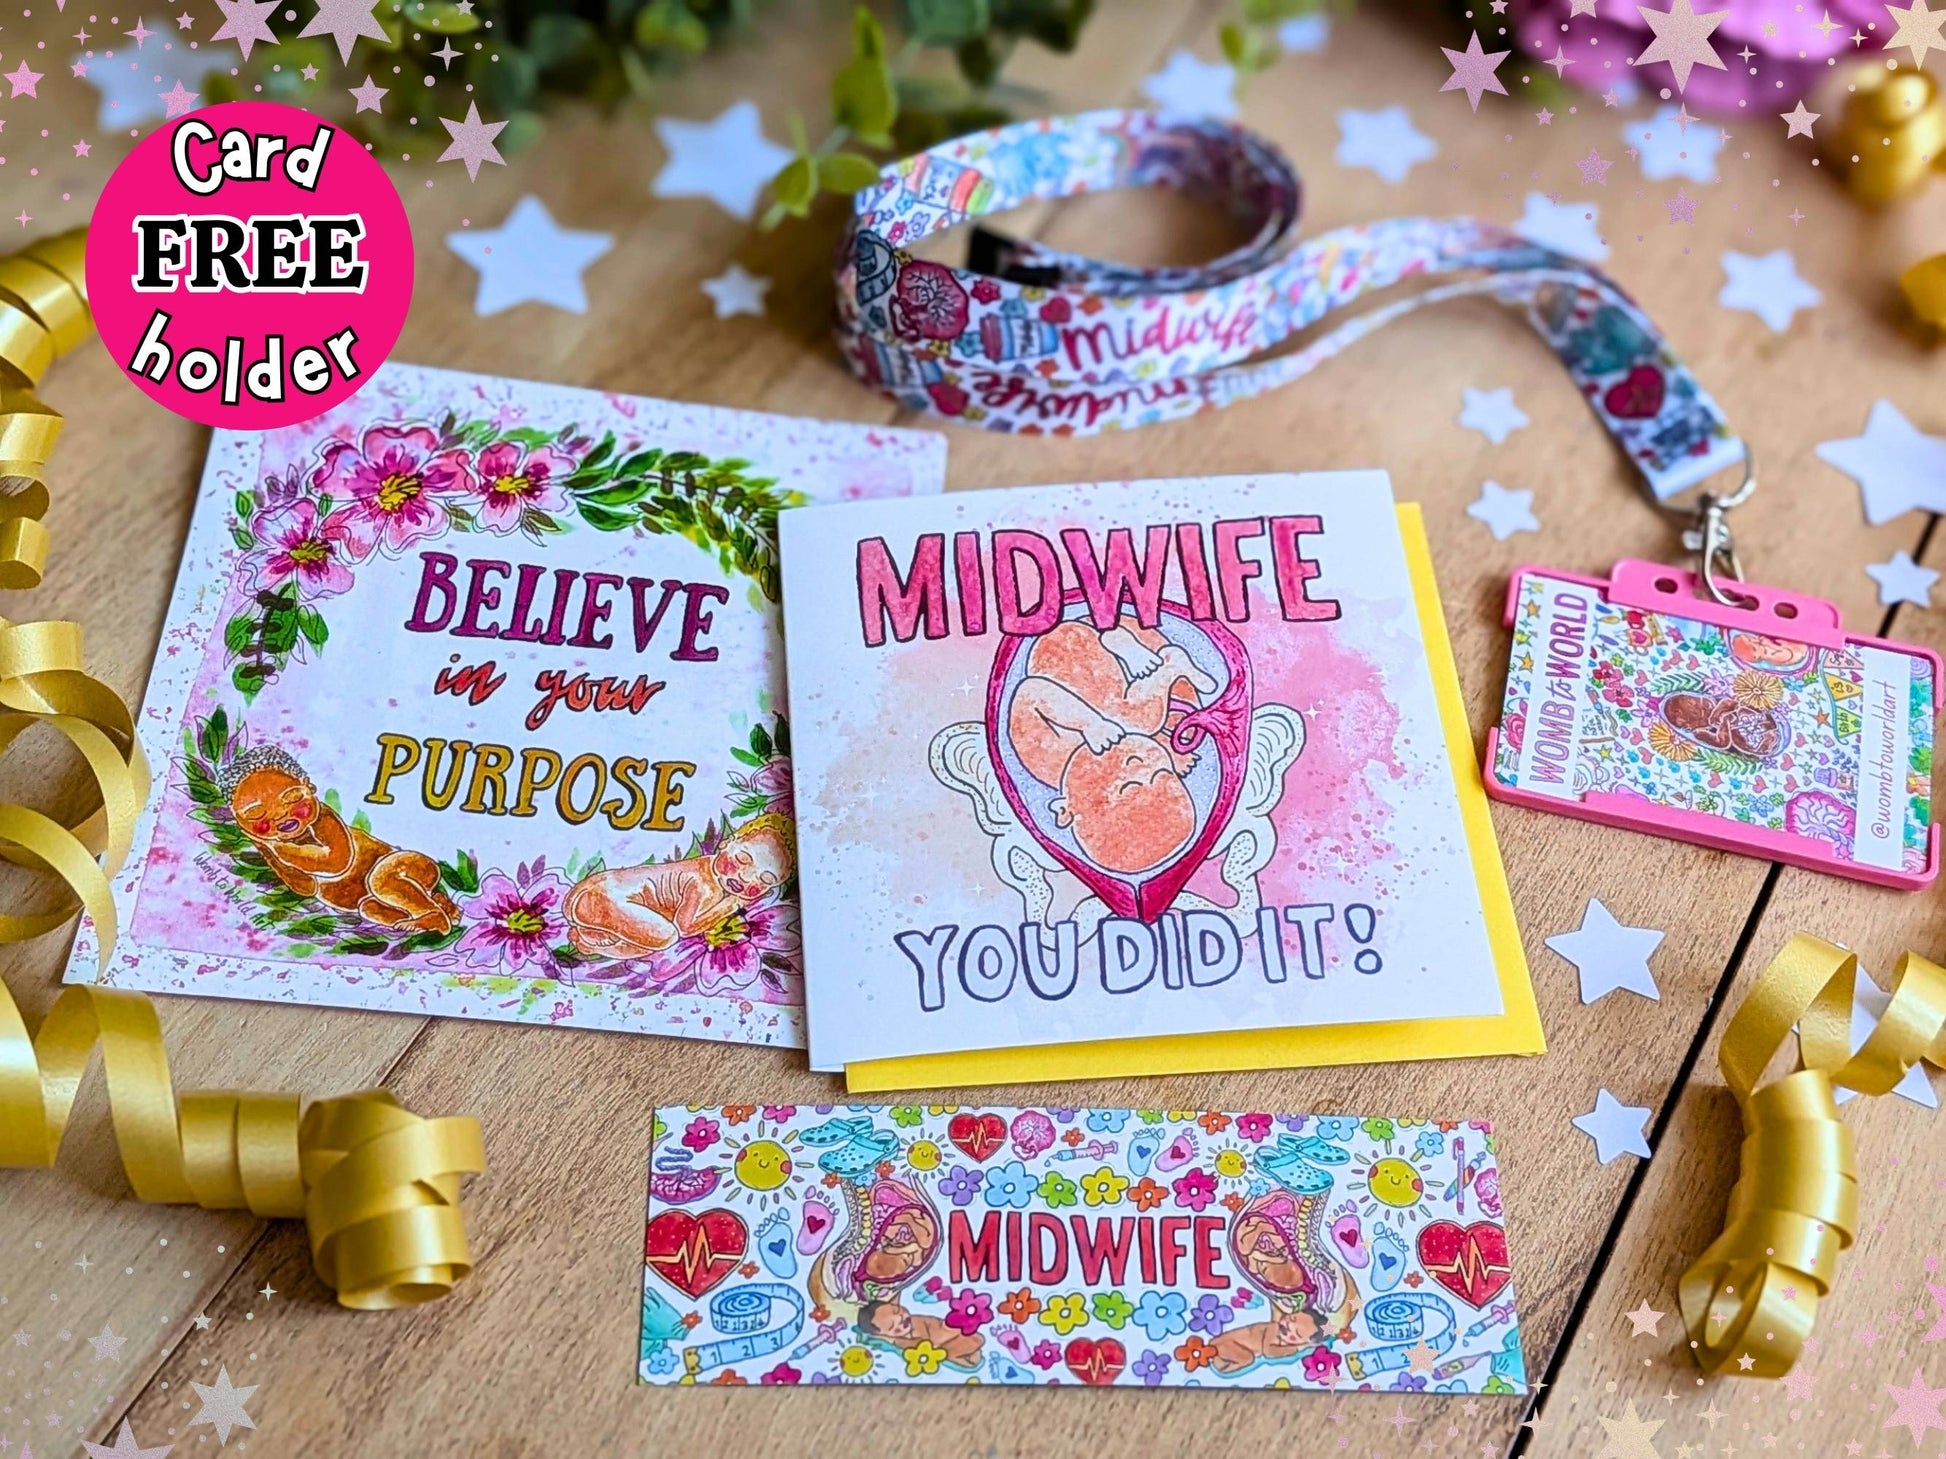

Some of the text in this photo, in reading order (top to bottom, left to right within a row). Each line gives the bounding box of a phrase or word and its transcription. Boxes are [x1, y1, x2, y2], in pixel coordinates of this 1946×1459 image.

[404, 551, 730, 662] BELIEVE
[856, 515, 1342, 648] MIDWIFE
[434, 653, 666, 731] in your
[1529, 592, 1588, 784] WOMB to WORLD
[364, 733, 698, 832] PURPOSE
[1868, 679, 1896, 839] @wombtoworldart
[895, 919, 1080, 1013] YOU
[1099, 910, 1243, 994] DID
[948, 1210, 1231, 1289] MIDWIFE
